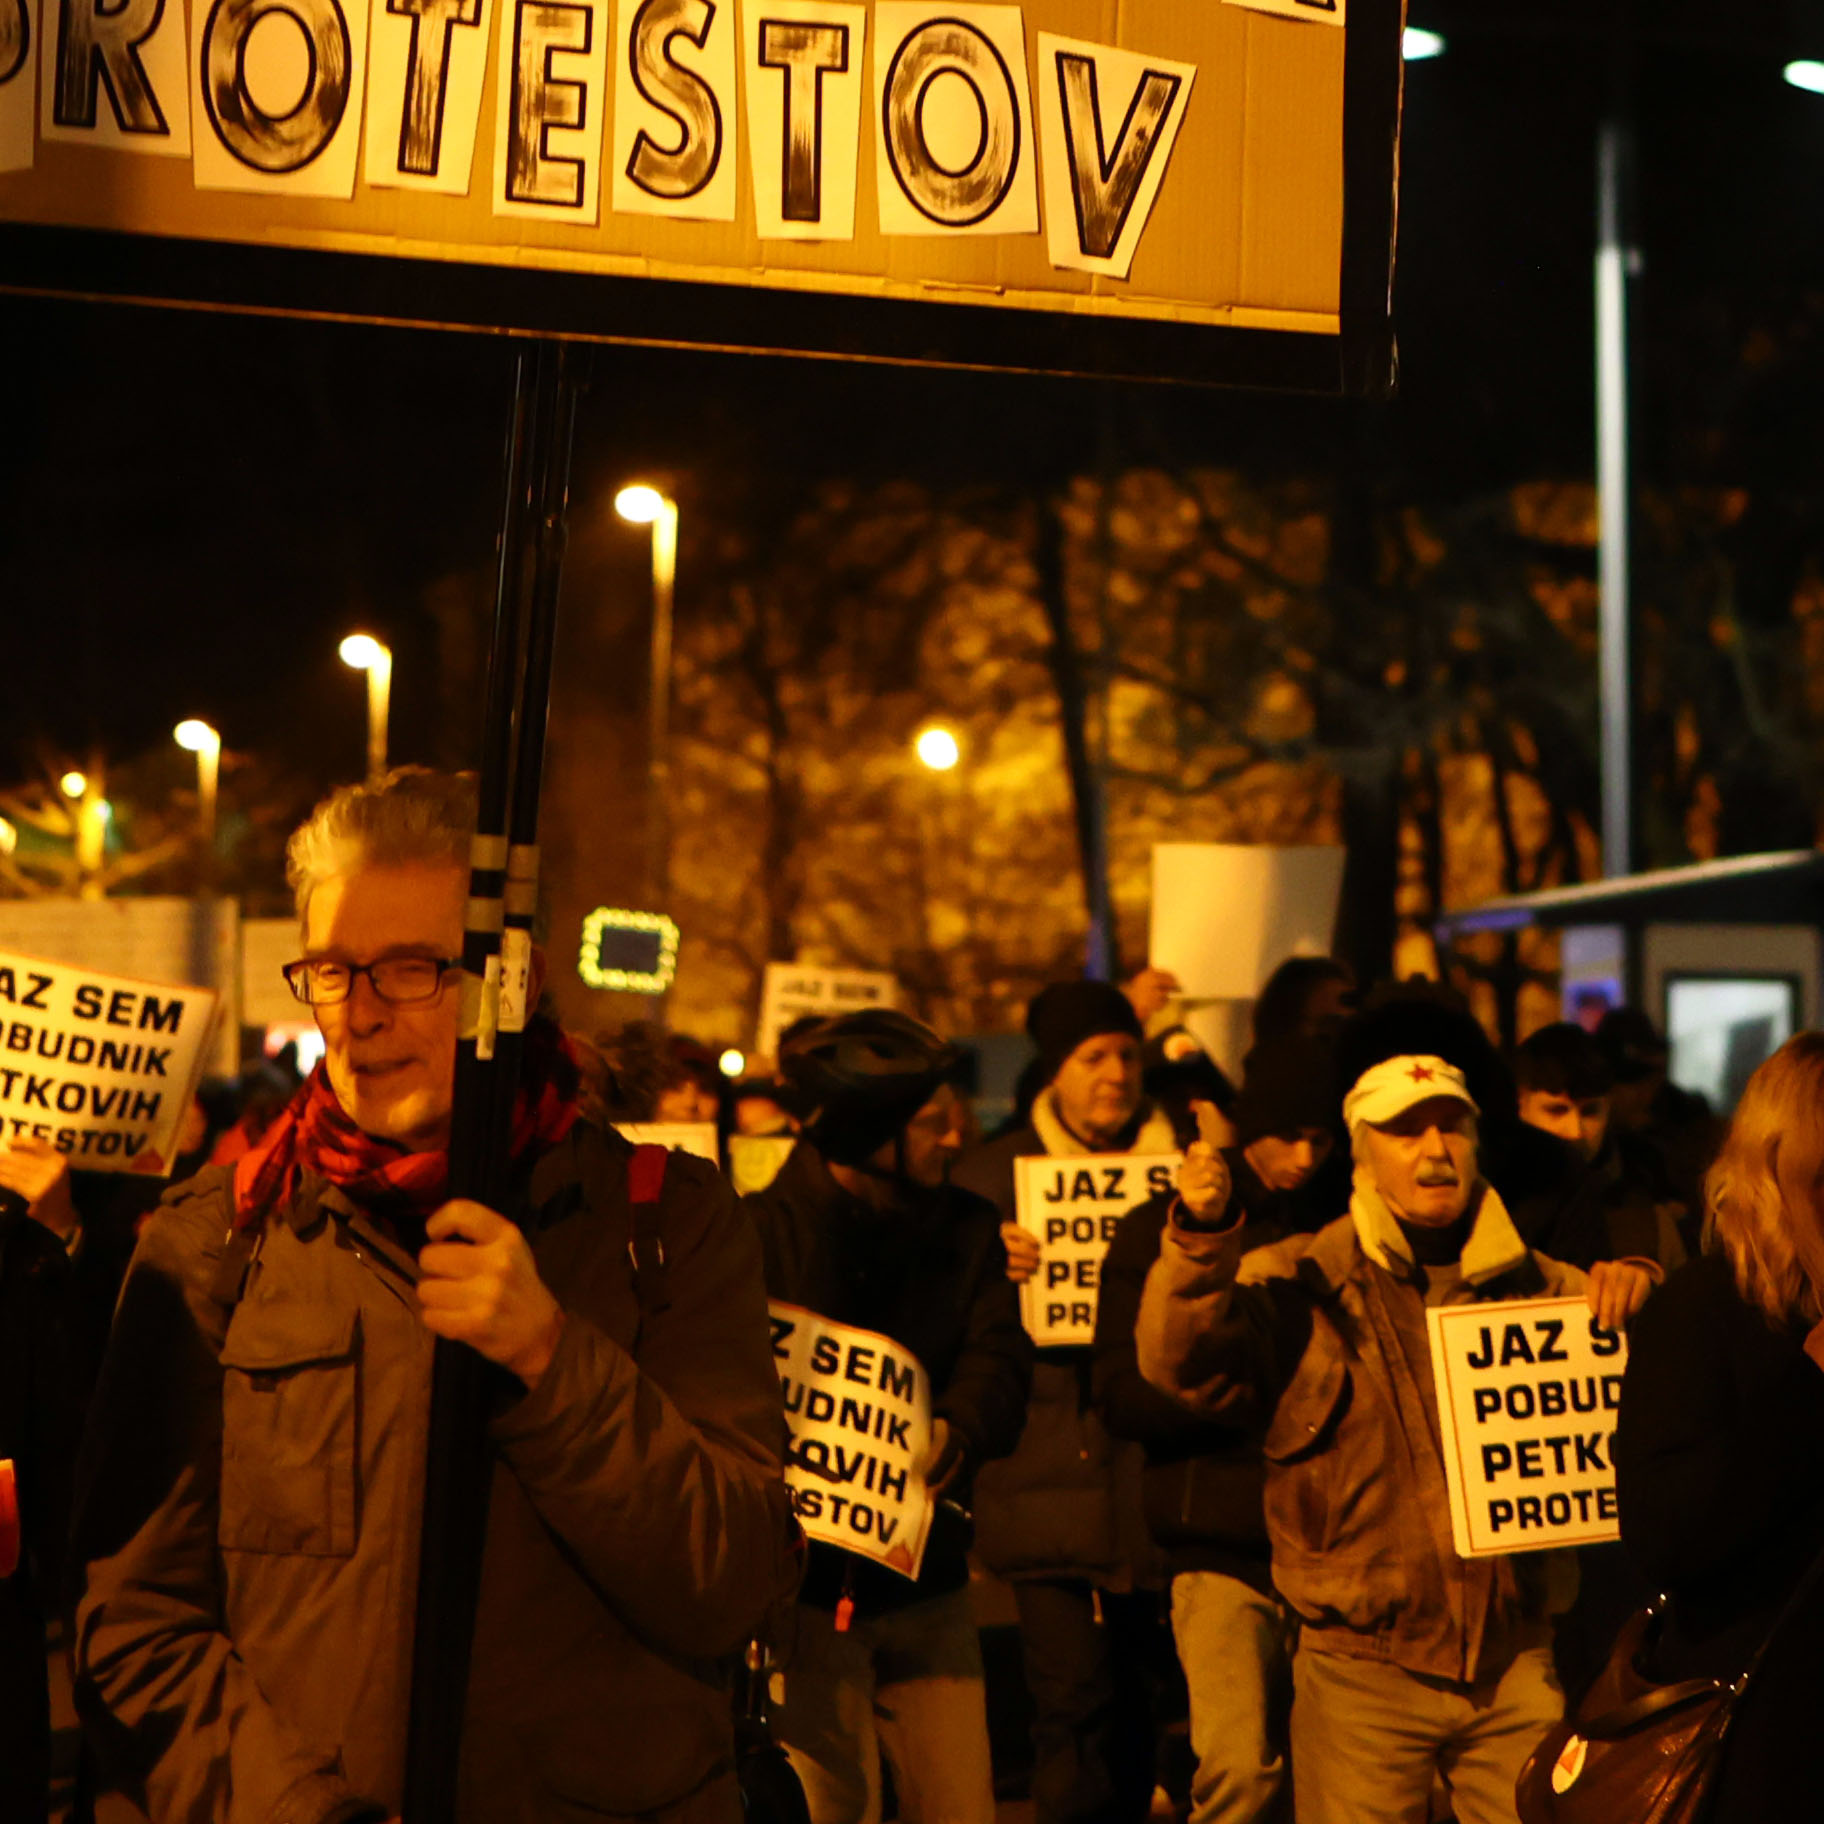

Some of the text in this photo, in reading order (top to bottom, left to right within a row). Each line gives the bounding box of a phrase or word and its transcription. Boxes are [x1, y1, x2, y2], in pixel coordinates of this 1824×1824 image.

[73, 985, 184, 1033] SEM
[1045, 1168, 1125, 1202] JAZ
[1047, 1303, 1091, 1327] PR
[1467, 1319, 1568, 1369] JAZ
[811, 1335, 914, 1405] SEM
[1482, 1431, 1617, 1482] PETK
